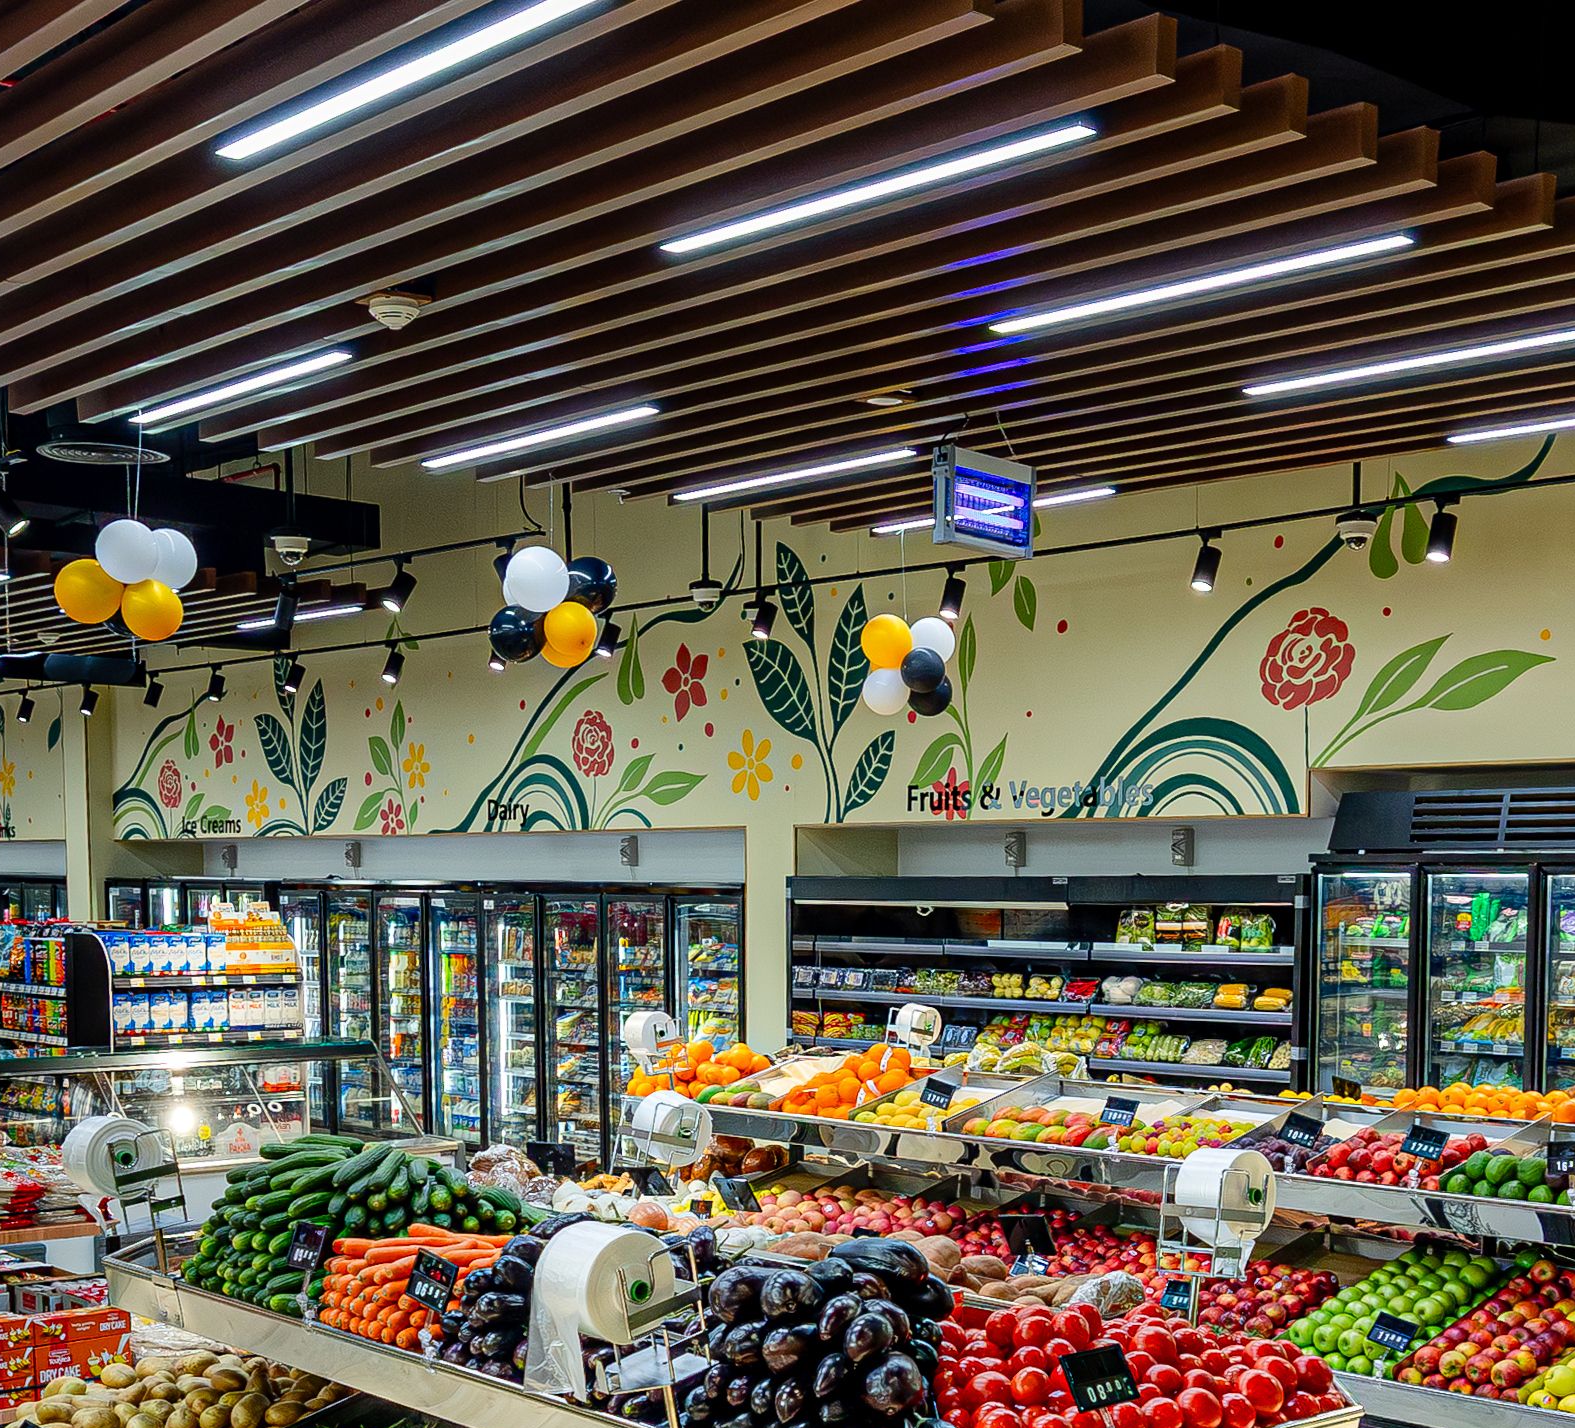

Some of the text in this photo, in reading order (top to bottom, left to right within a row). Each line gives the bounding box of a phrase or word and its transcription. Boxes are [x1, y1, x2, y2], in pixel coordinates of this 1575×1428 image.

[907, 775, 1155, 817] Fruits & Vegetables
[182, 814, 242, 835] Ice Creams
[487, 799, 530, 828] Dairy
[40, 1368, 58, 1384] DRY
